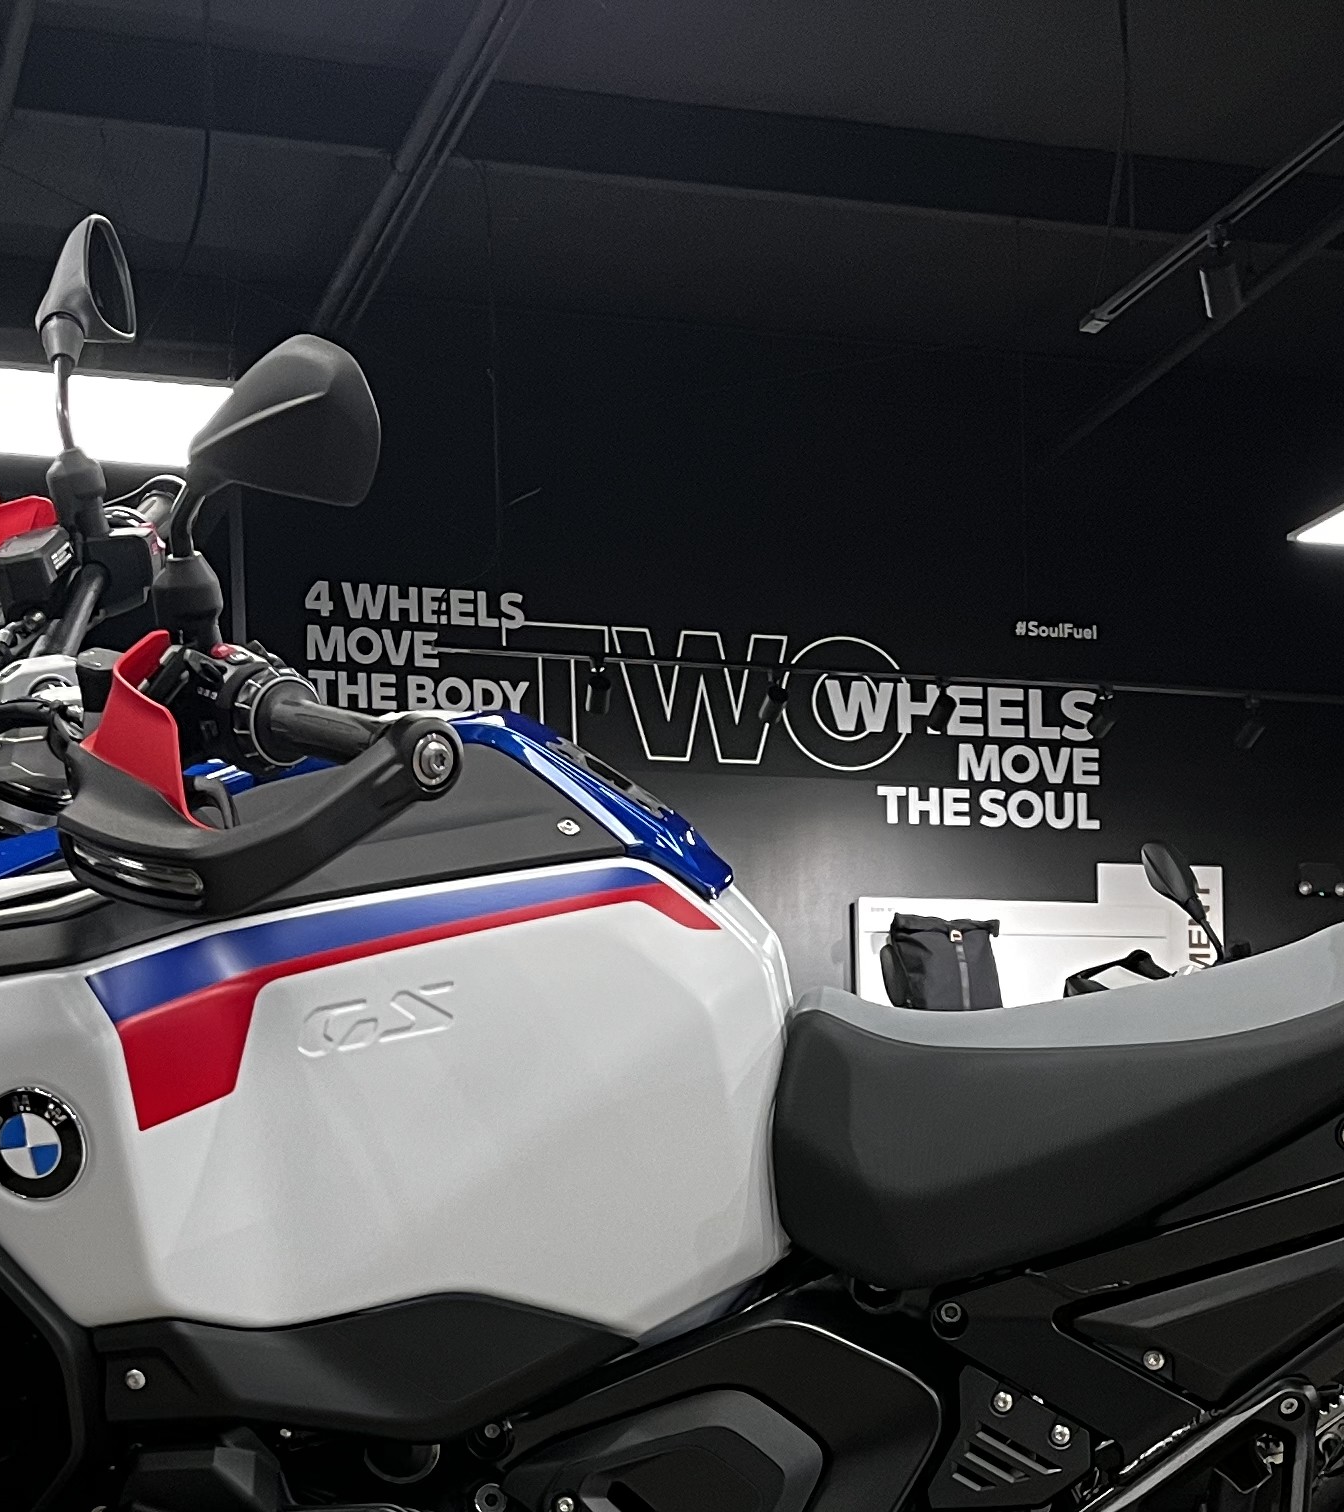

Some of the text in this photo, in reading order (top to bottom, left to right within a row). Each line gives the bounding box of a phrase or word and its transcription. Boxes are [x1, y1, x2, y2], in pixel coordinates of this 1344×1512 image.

[305, 580, 525, 629] 4 WHEELS
[307, 625, 440, 668] MOVE
[1015, 620, 1098, 640] #SoulFuel
[308, 669, 530, 714] THE BODY
[502, 619, 912, 772] TWO
[824, 679, 1100, 741] WHEELS
[958, 743, 1100, 785] MOVE
[877, 785, 1101, 830] THE SOUL
